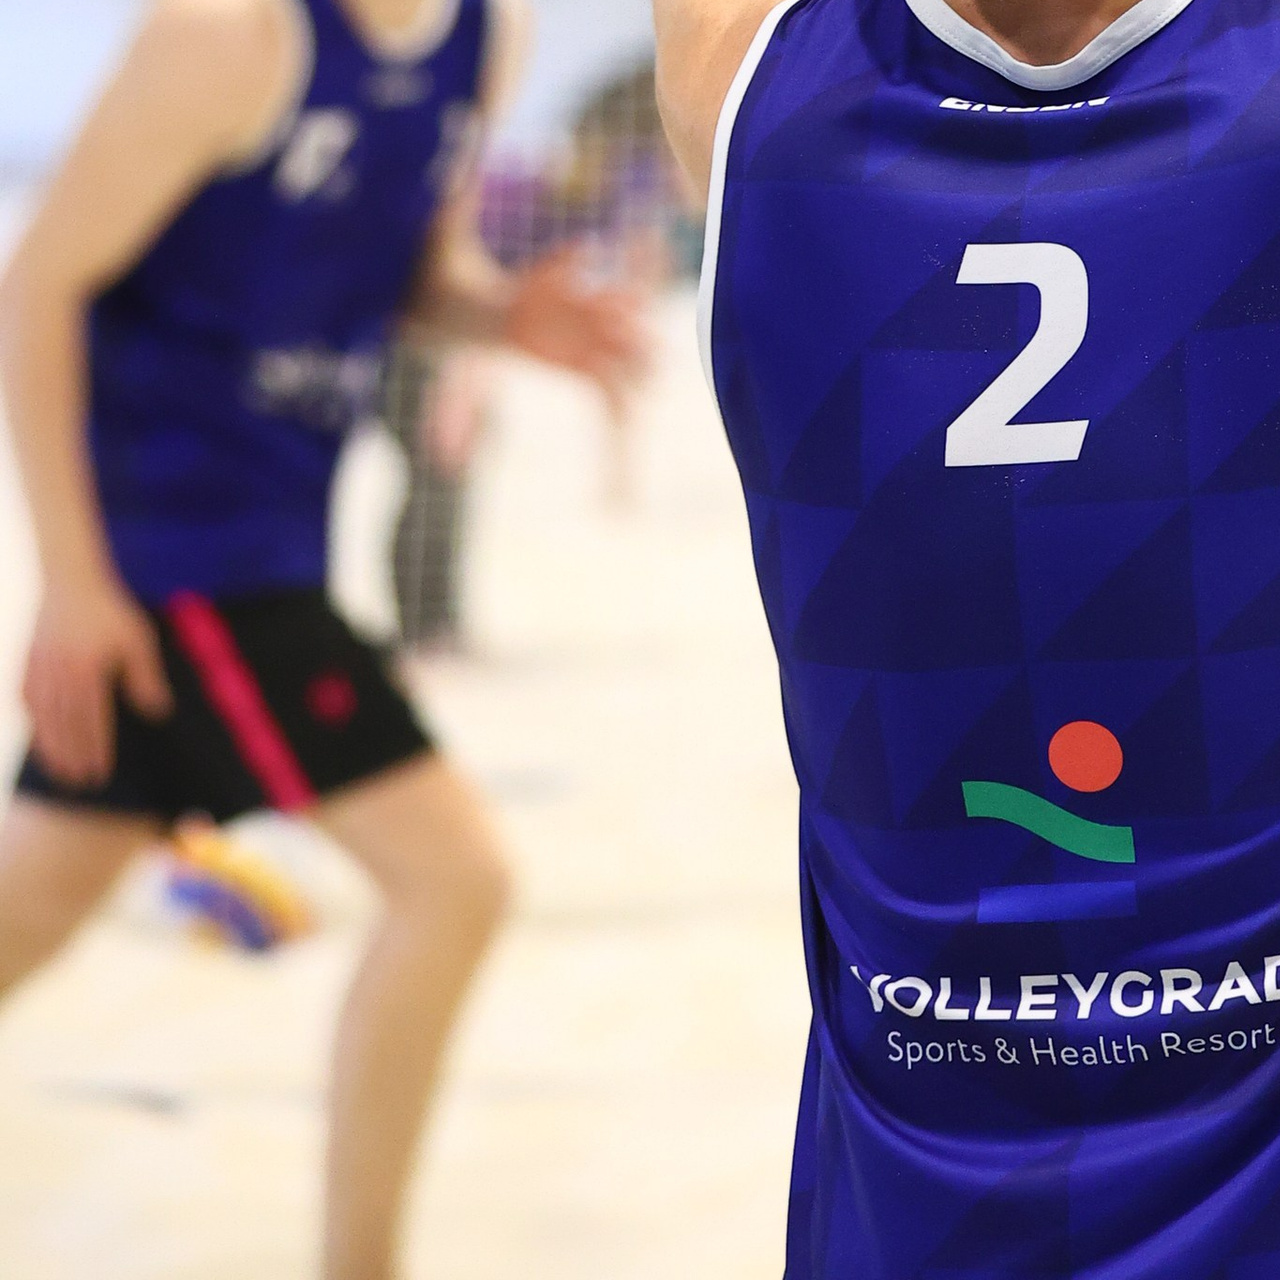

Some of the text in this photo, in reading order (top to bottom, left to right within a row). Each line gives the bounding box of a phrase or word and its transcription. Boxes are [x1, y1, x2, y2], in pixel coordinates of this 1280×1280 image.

[945, 242, 1090, 467] 2
[887, 1024, 1276, 1070] Sports & Health Resort
